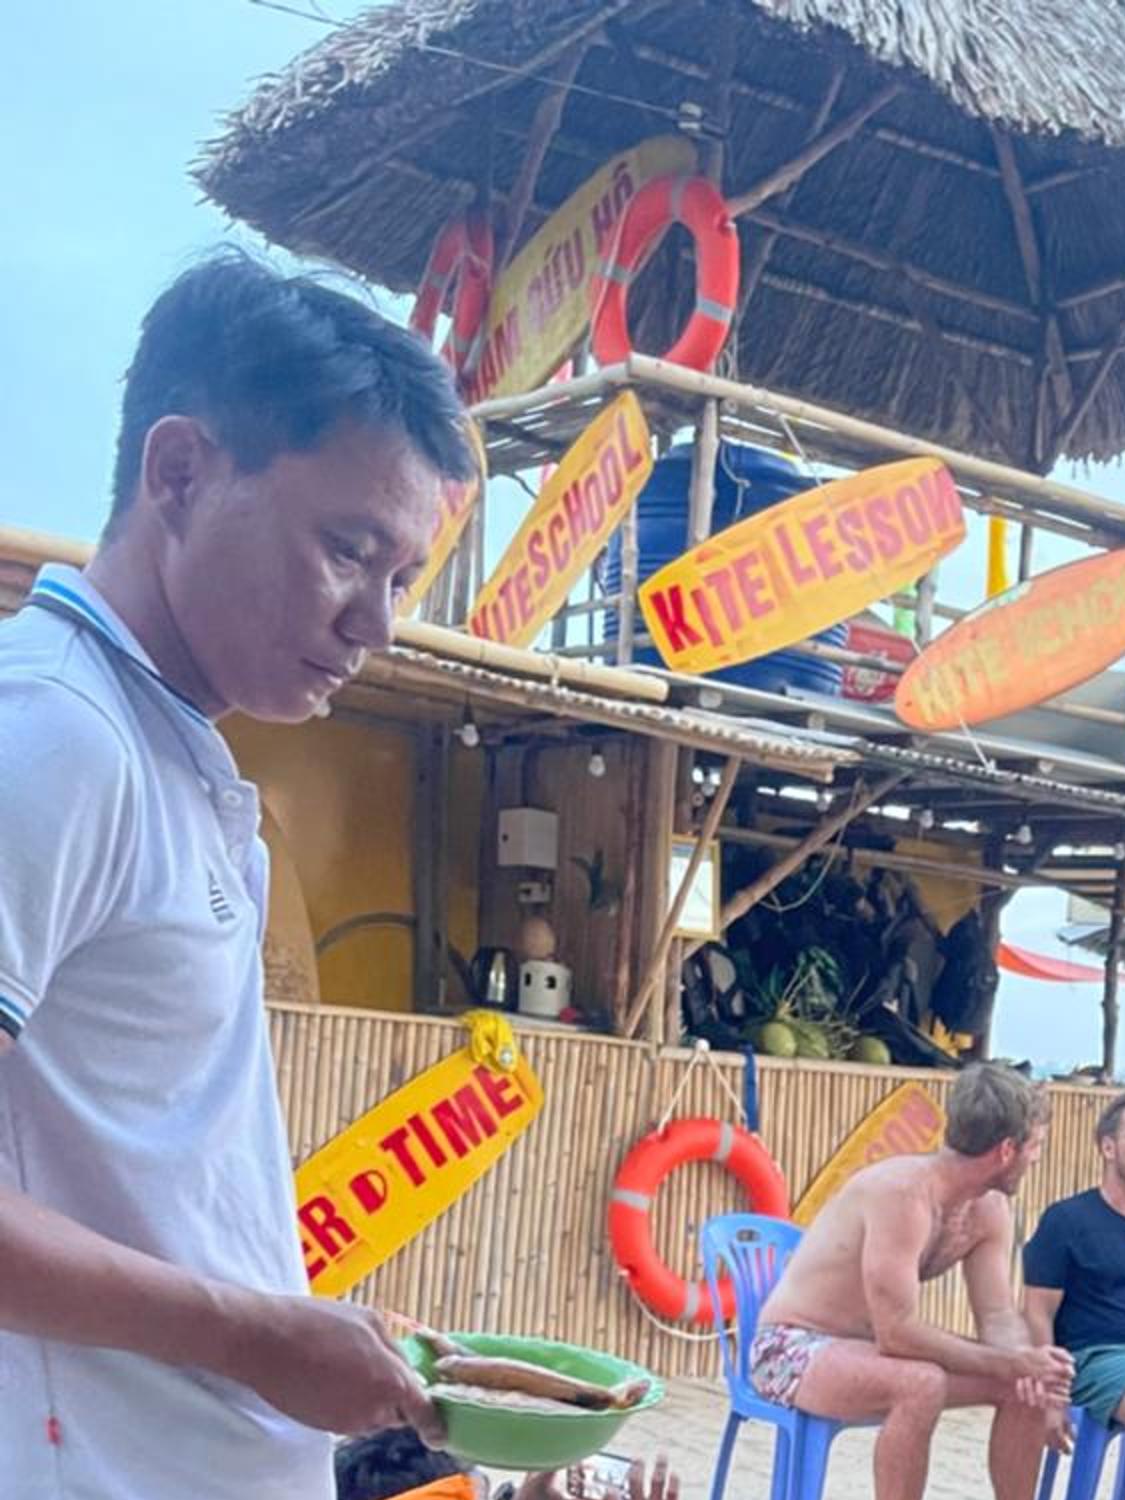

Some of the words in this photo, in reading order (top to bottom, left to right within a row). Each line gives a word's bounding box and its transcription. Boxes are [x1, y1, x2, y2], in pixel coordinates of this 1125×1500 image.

[650, 548, 776, 653] KITE
[773, 466, 964, 588] LESSON
[377, 1064, 525, 1189] TIME
